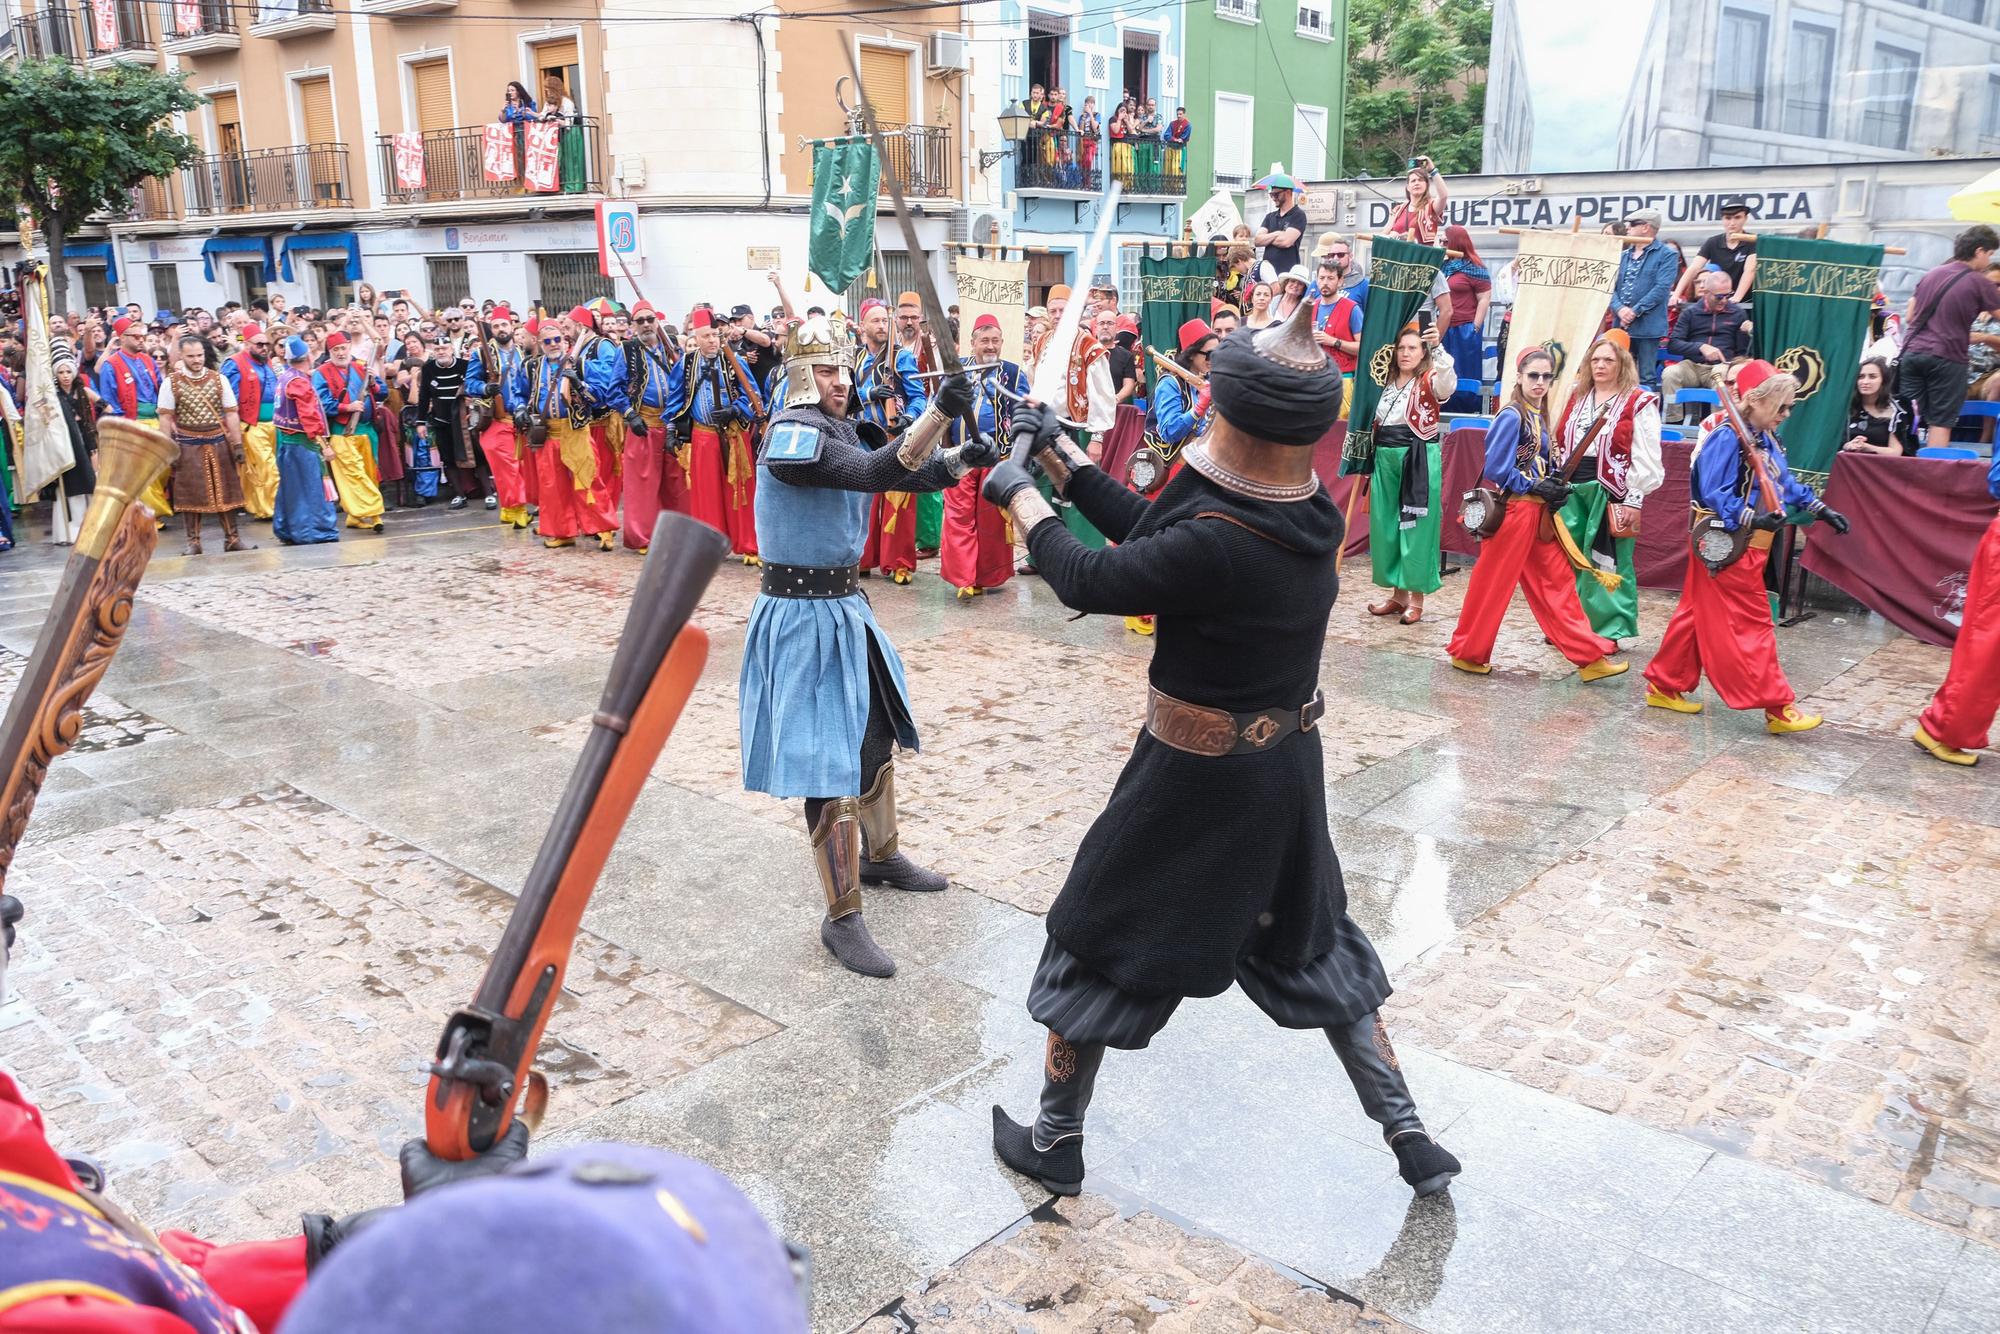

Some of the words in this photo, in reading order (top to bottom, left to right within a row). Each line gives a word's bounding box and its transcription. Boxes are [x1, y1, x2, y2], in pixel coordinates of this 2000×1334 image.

[1369, 198, 1553, 228] DUERIA
[1558, 203, 1573, 225] y
[612, 216, 632, 249] B
